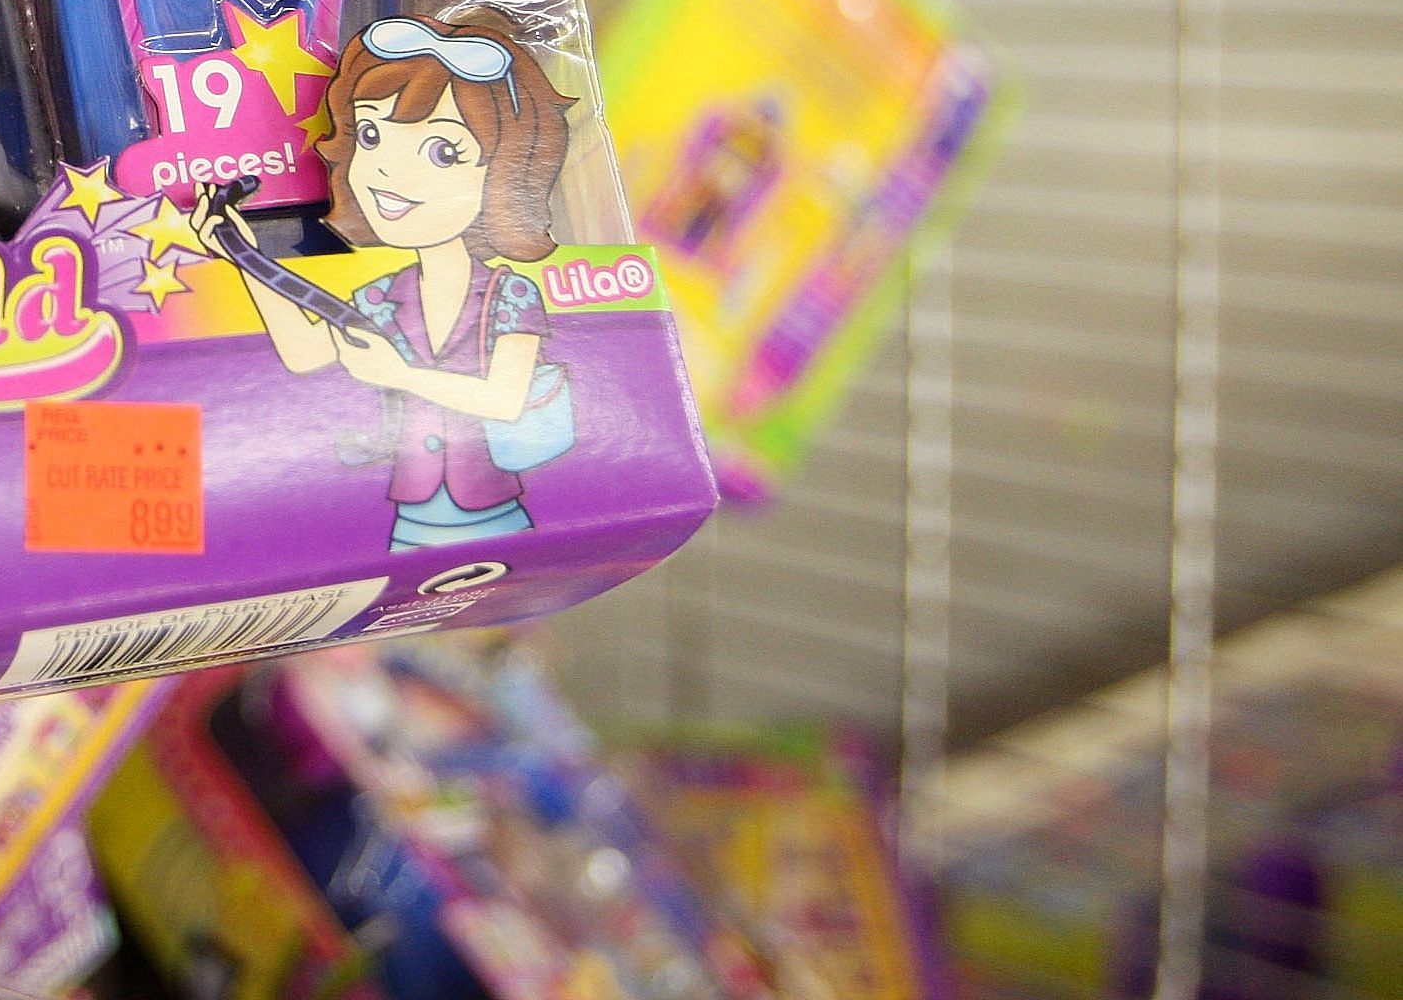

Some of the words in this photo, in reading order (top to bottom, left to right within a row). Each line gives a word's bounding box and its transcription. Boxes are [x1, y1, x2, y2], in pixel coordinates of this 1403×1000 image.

[152, 59, 245, 134] 19
[152, 147, 296, 191] pieces!
[47, 465, 80, 489] CUT
[84, 465, 129, 490] RATE
[133, 466, 183, 490] PRICE
[55, 613, 152, 642] PROOF
[158, 607, 200, 627] OF
[203, 586, 354, 619] PURCHASE
